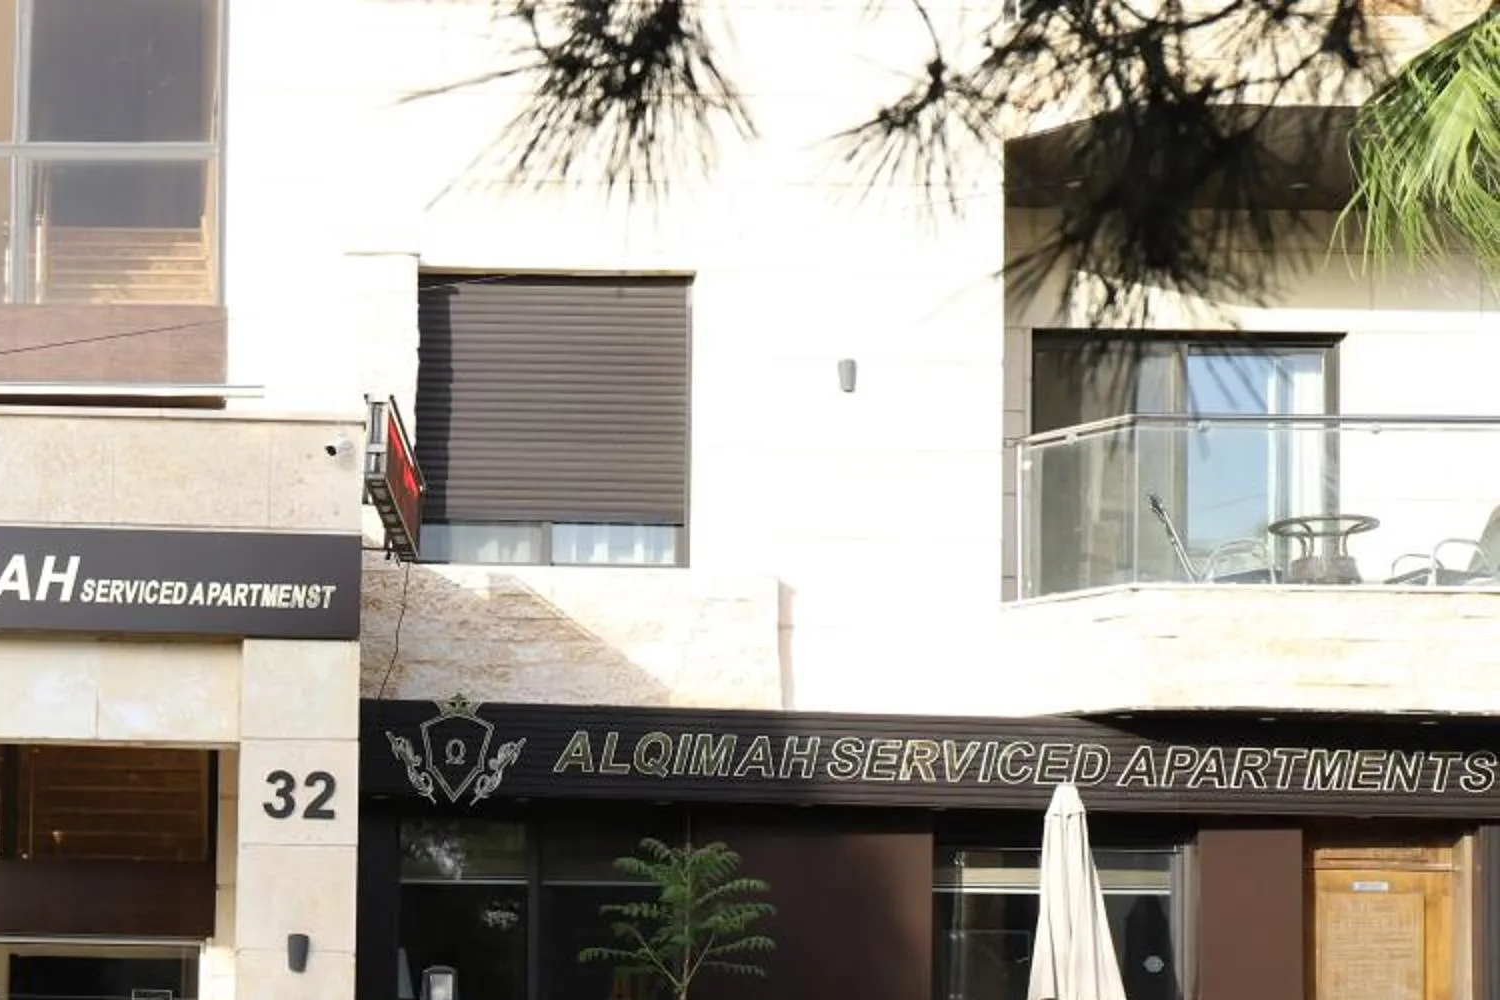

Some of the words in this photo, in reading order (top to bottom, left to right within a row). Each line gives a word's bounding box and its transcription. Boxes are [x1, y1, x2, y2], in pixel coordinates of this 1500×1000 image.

[80, 578, 188, 605] SERVICED
[188, 581, 336, 609] APARTMENST
[552, 730, 820, 779] ALQIMAH
[827, 736, 1111, 785] SERVICED
[1115, 744, 1499, 794] APARTMENTS
[263, 769, 337, 819] 32
